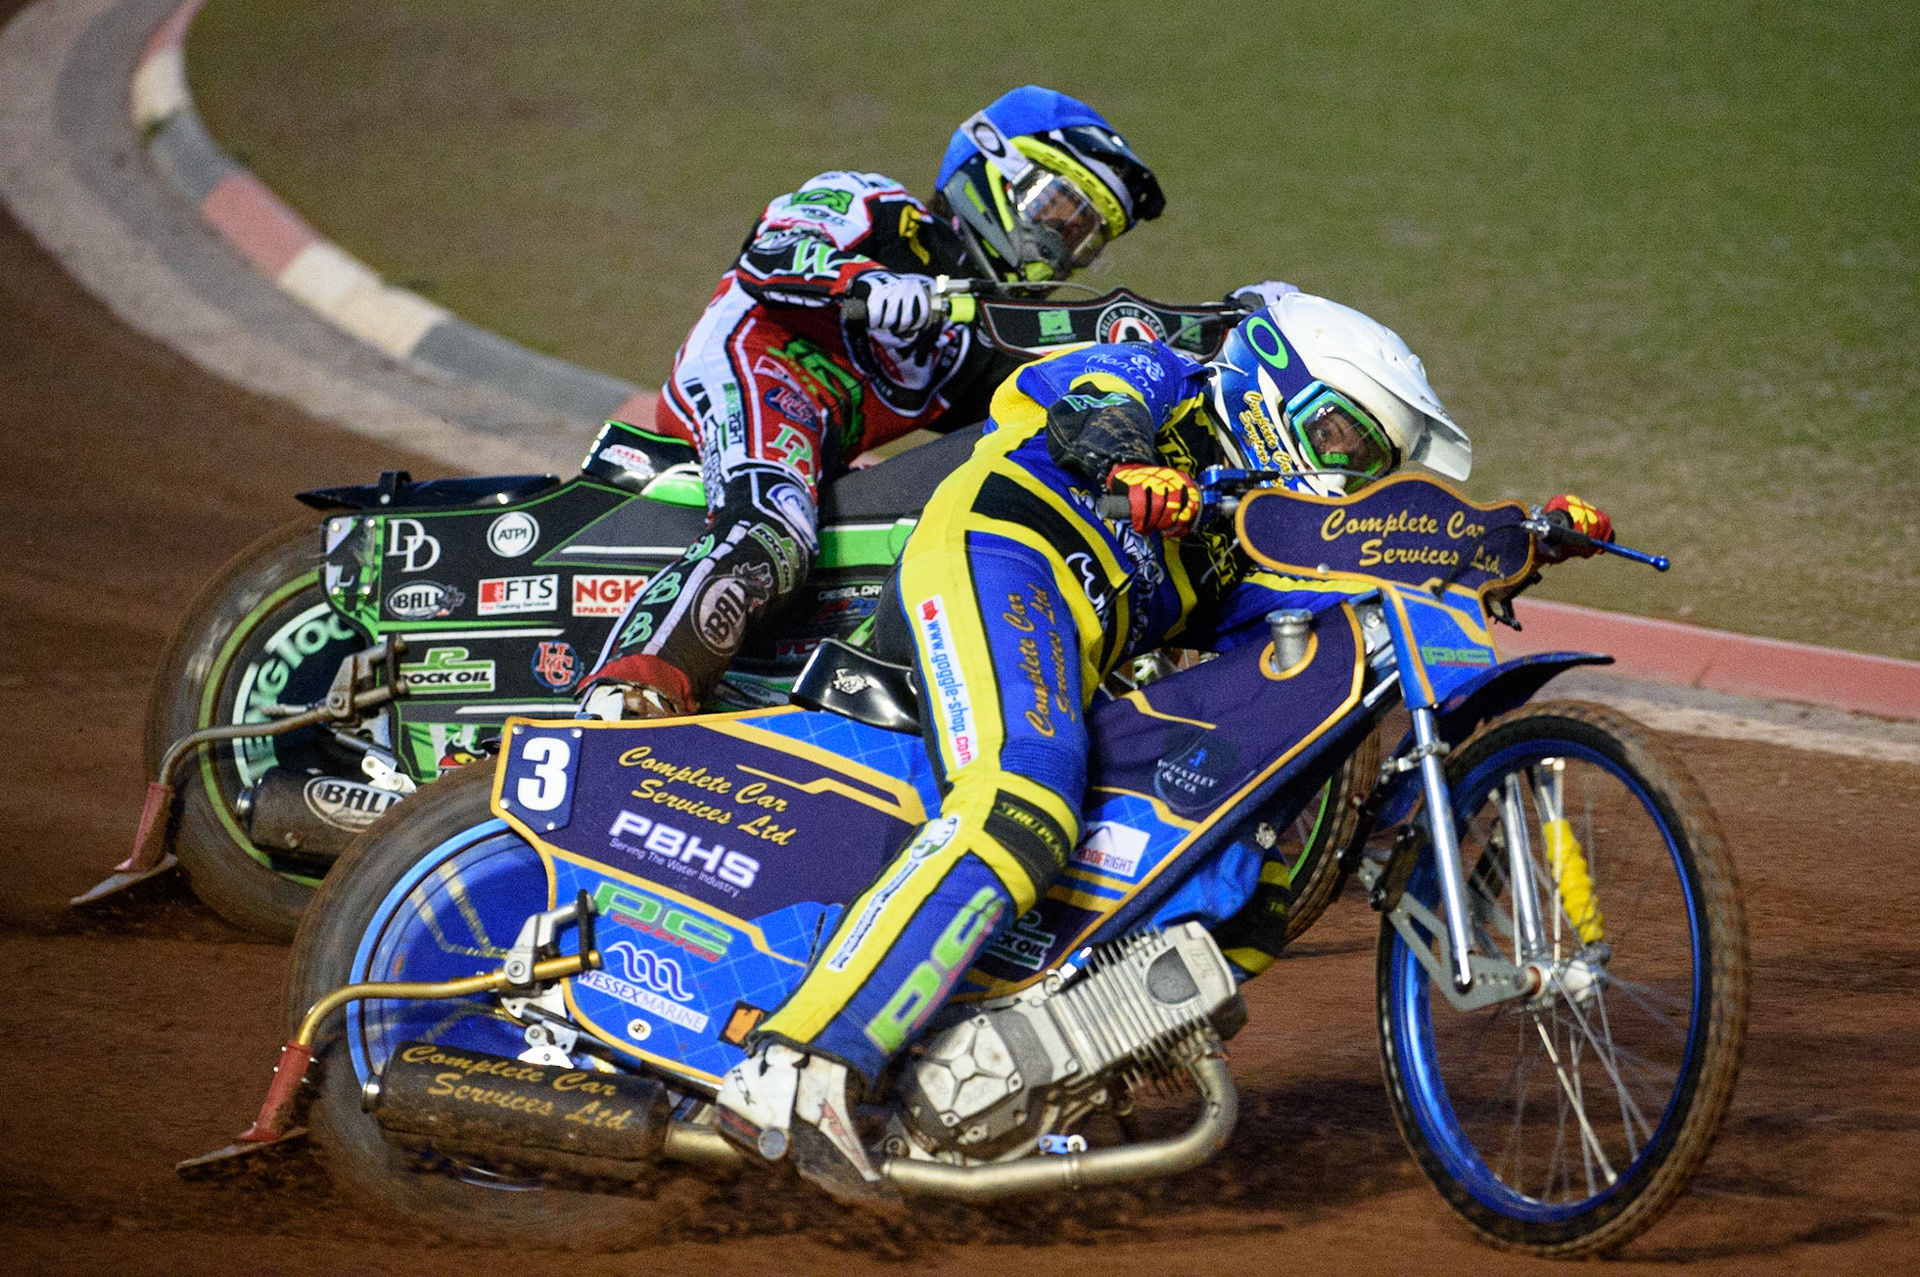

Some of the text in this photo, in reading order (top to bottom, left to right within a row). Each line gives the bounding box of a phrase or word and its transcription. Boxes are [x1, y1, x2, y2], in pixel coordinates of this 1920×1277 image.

[1119, 307, 1140, 317] VUE
[498, 527, 528, 541] ATPI
[1320, 508, 1487, 542] Complete Car
[1358, 539, 1460, 567] Services
[506, 578, 553, 599] FTS
[575, 579, 644, 602] NGK
[576, 606, 608, 614] SPARK
[456, 671, 490, 683] OIL
[1003, 593, 1055, 738] Complete Car
[926, 620, 971, 765] www.goggle-shop.com
[517, 736, 571, 811] 3
[618, 745, 788, 813] Complete Car
[631, 778, 798, 847] Services Ltd
[609, 809, 760, 889] PBHS
[609, 837, 740, 898] Serving The Water Industry
[402, 1045, 618, 1097] Complete Car
[427, 1072, 633, 1131] Services Ltd
